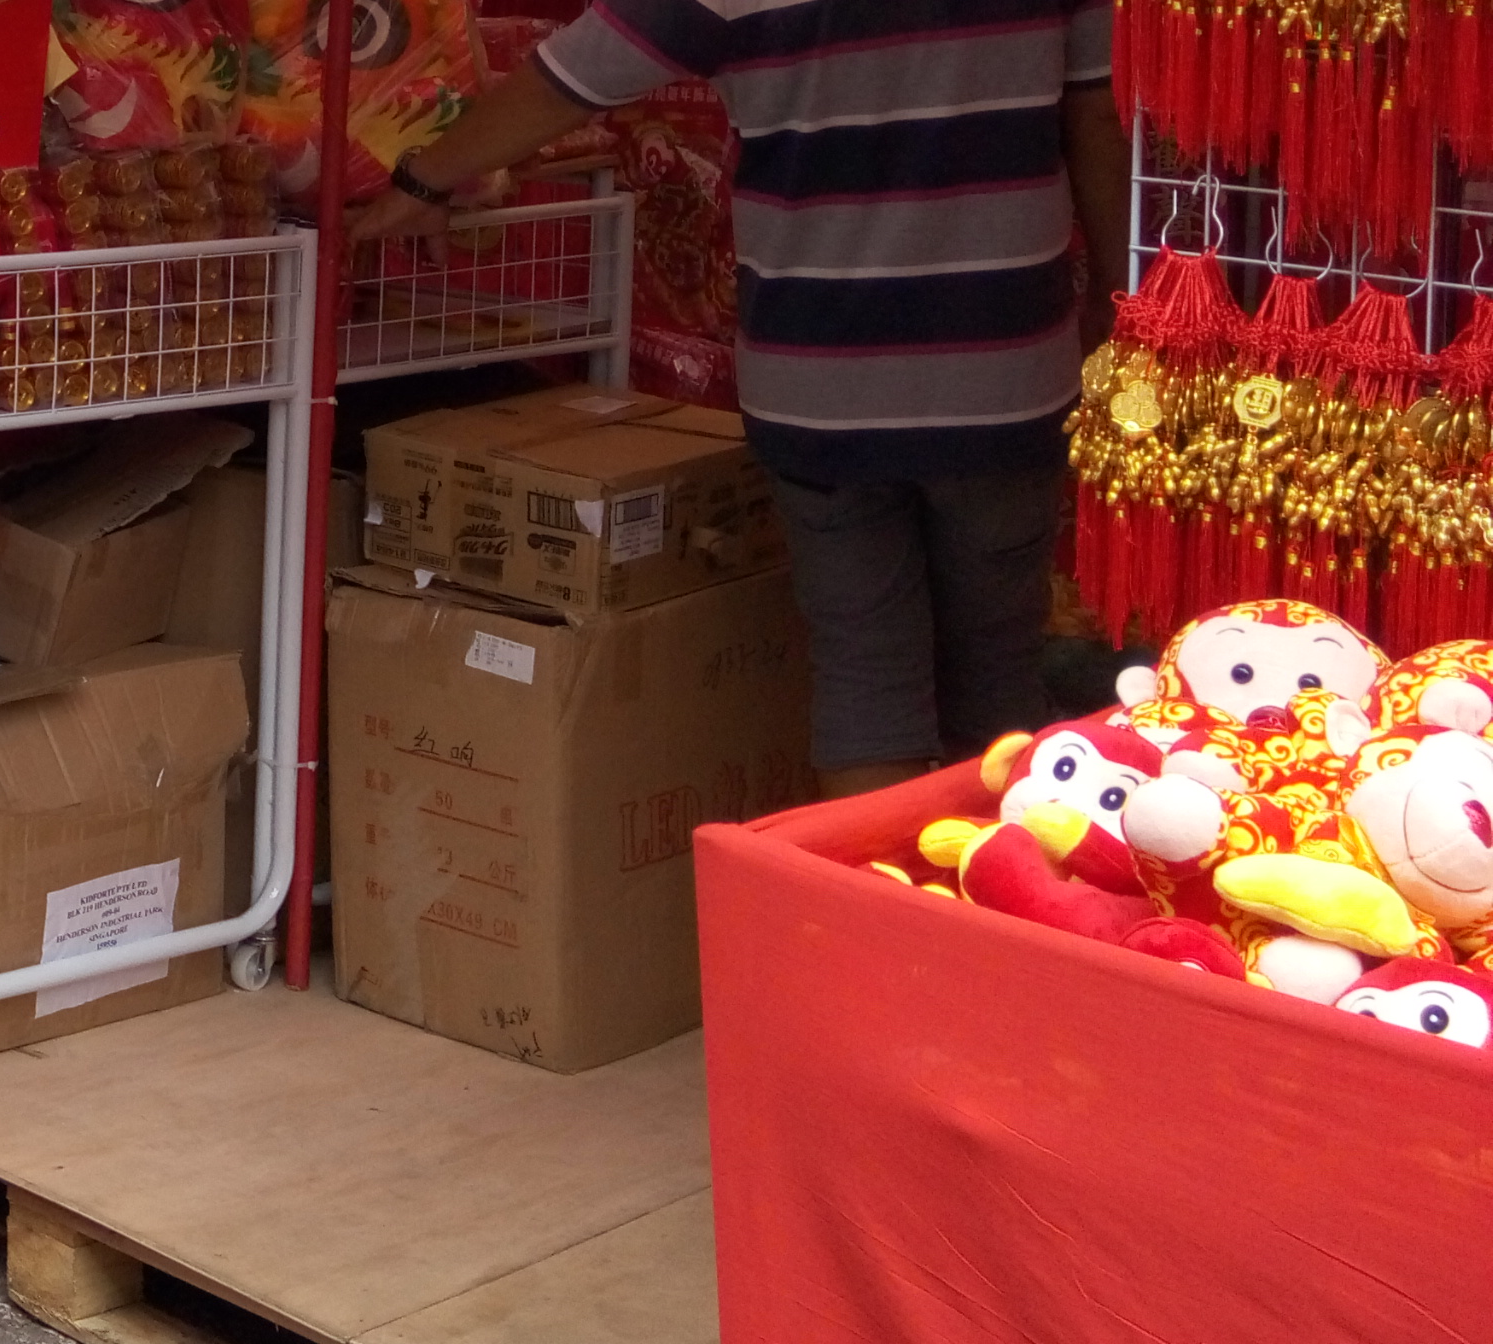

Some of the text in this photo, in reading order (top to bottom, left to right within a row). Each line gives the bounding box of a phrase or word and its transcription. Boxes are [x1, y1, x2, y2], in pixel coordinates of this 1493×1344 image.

[434, 790, 453, 810] 50
[488, 860, 517, 884] 公斤
[94, 892, 137, 911] HENDERSON
[55, 922, 100, 944] HENDERSON
[89, 924, 129, 943] SINGAPORE
[493, 919, 519, 942] CM
